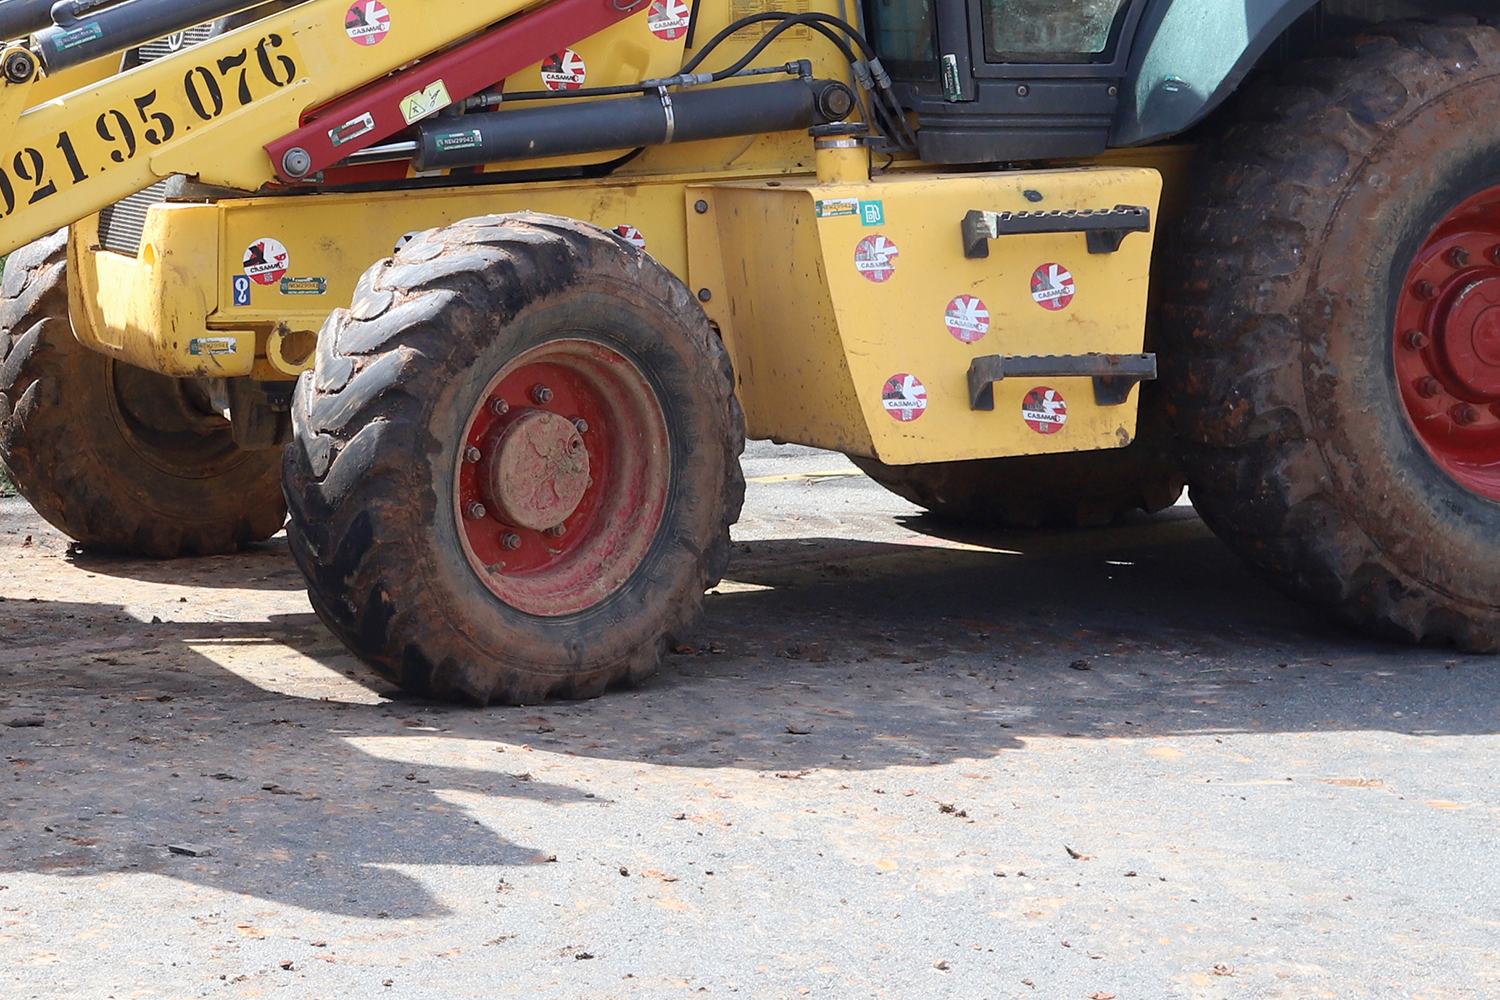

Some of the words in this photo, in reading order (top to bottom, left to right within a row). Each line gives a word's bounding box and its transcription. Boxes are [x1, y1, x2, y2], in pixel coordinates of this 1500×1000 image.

[351, 23, 386, 35] CASAMAC
[653, 18, 686, 30] CASAMAC
[546, 73, 580, 83] CASAMAC
[250, 261, 285, 273] CASAMAC
[1037, 286, 1071, 299] CASAMAC
[888, 399, 923, 408] CASAMAC
[1027, 412, 1061, 422] CASAMAC
